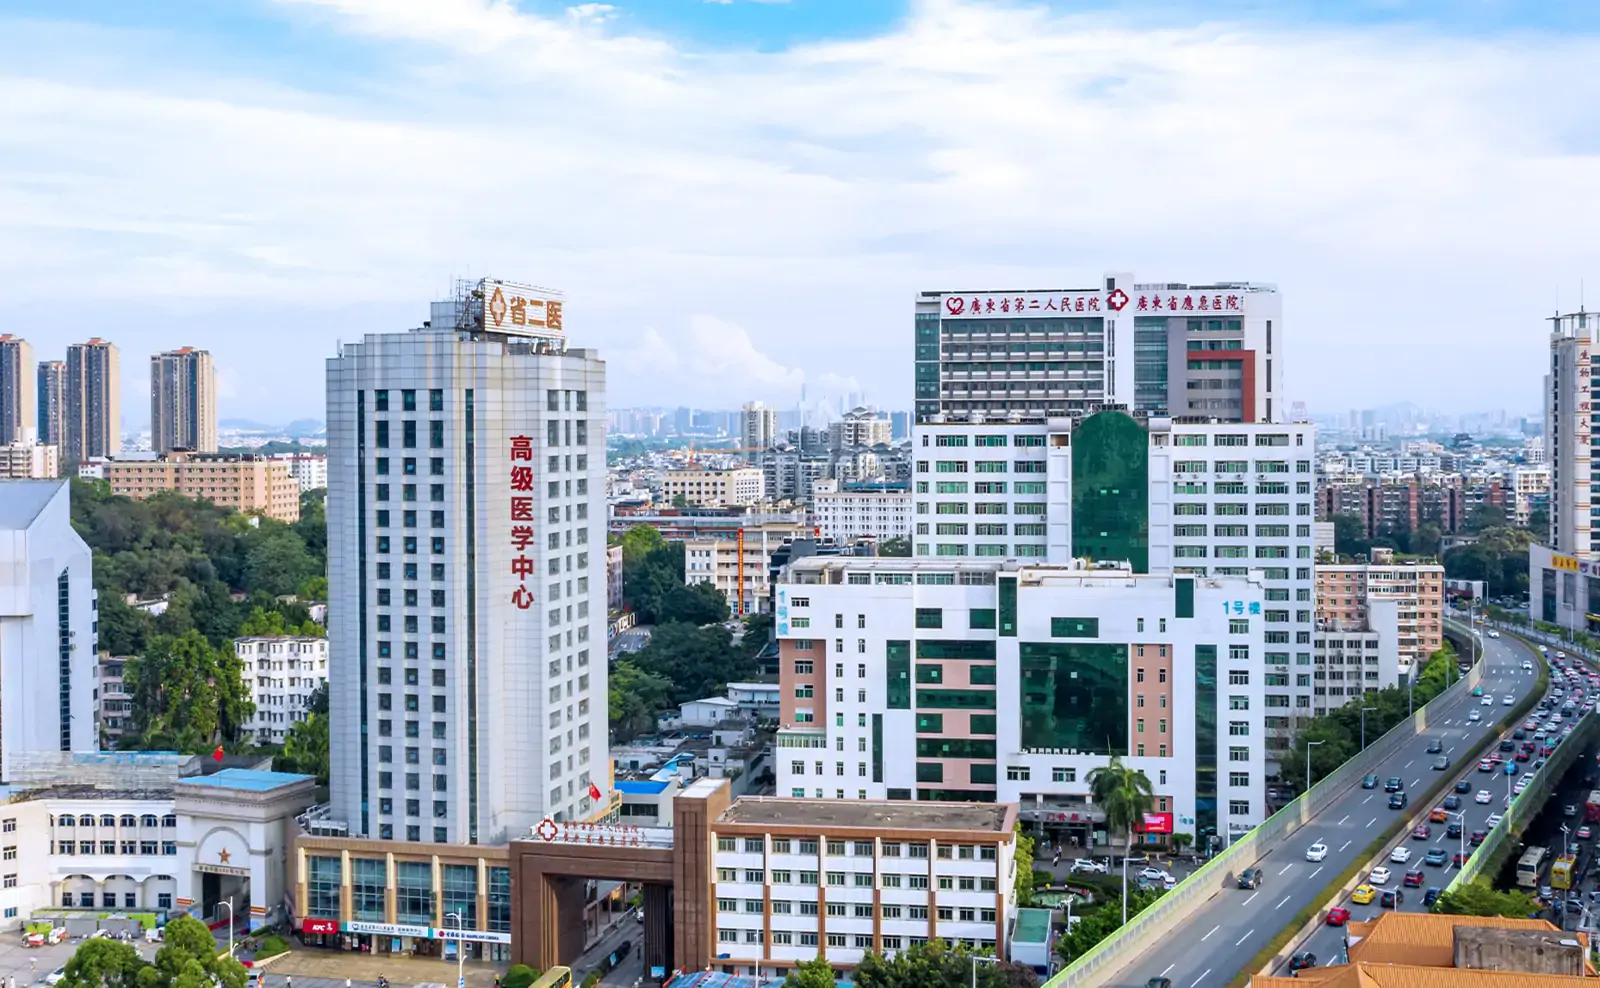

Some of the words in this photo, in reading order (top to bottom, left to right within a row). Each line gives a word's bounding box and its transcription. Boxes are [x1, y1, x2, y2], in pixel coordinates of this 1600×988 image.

[510, 296, 562, 330] 省二医
[970, 297, 1101, 315] 廣東省第二人民医院
[1579, 349, 1590, 445] 生物工程大厦
[510, 435, 534, 610] 高级医学中心
[1222, 600, 1261, 615] 1号楼
